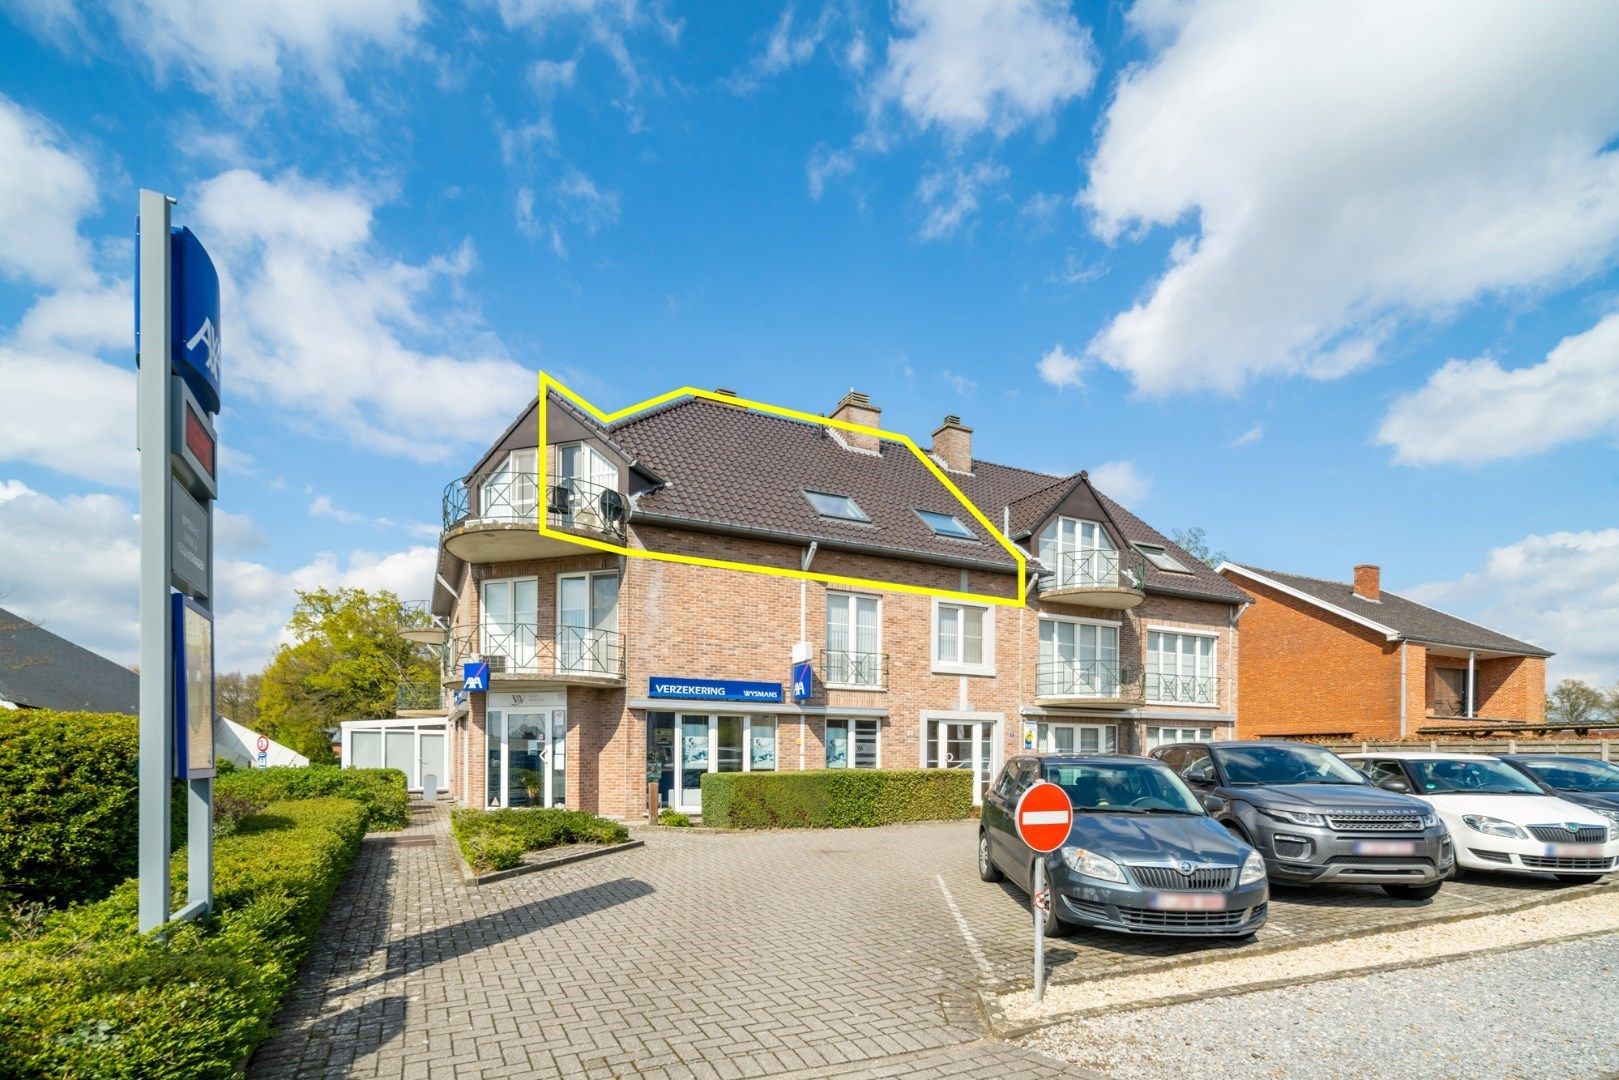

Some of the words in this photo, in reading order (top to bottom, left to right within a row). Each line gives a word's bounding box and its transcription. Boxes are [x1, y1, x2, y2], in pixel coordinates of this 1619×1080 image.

[463, 676, 483, 689] AXA
[655, 683, 725, 696] VERZEKERING
[742, 689, 778, 698] WYSMANS
